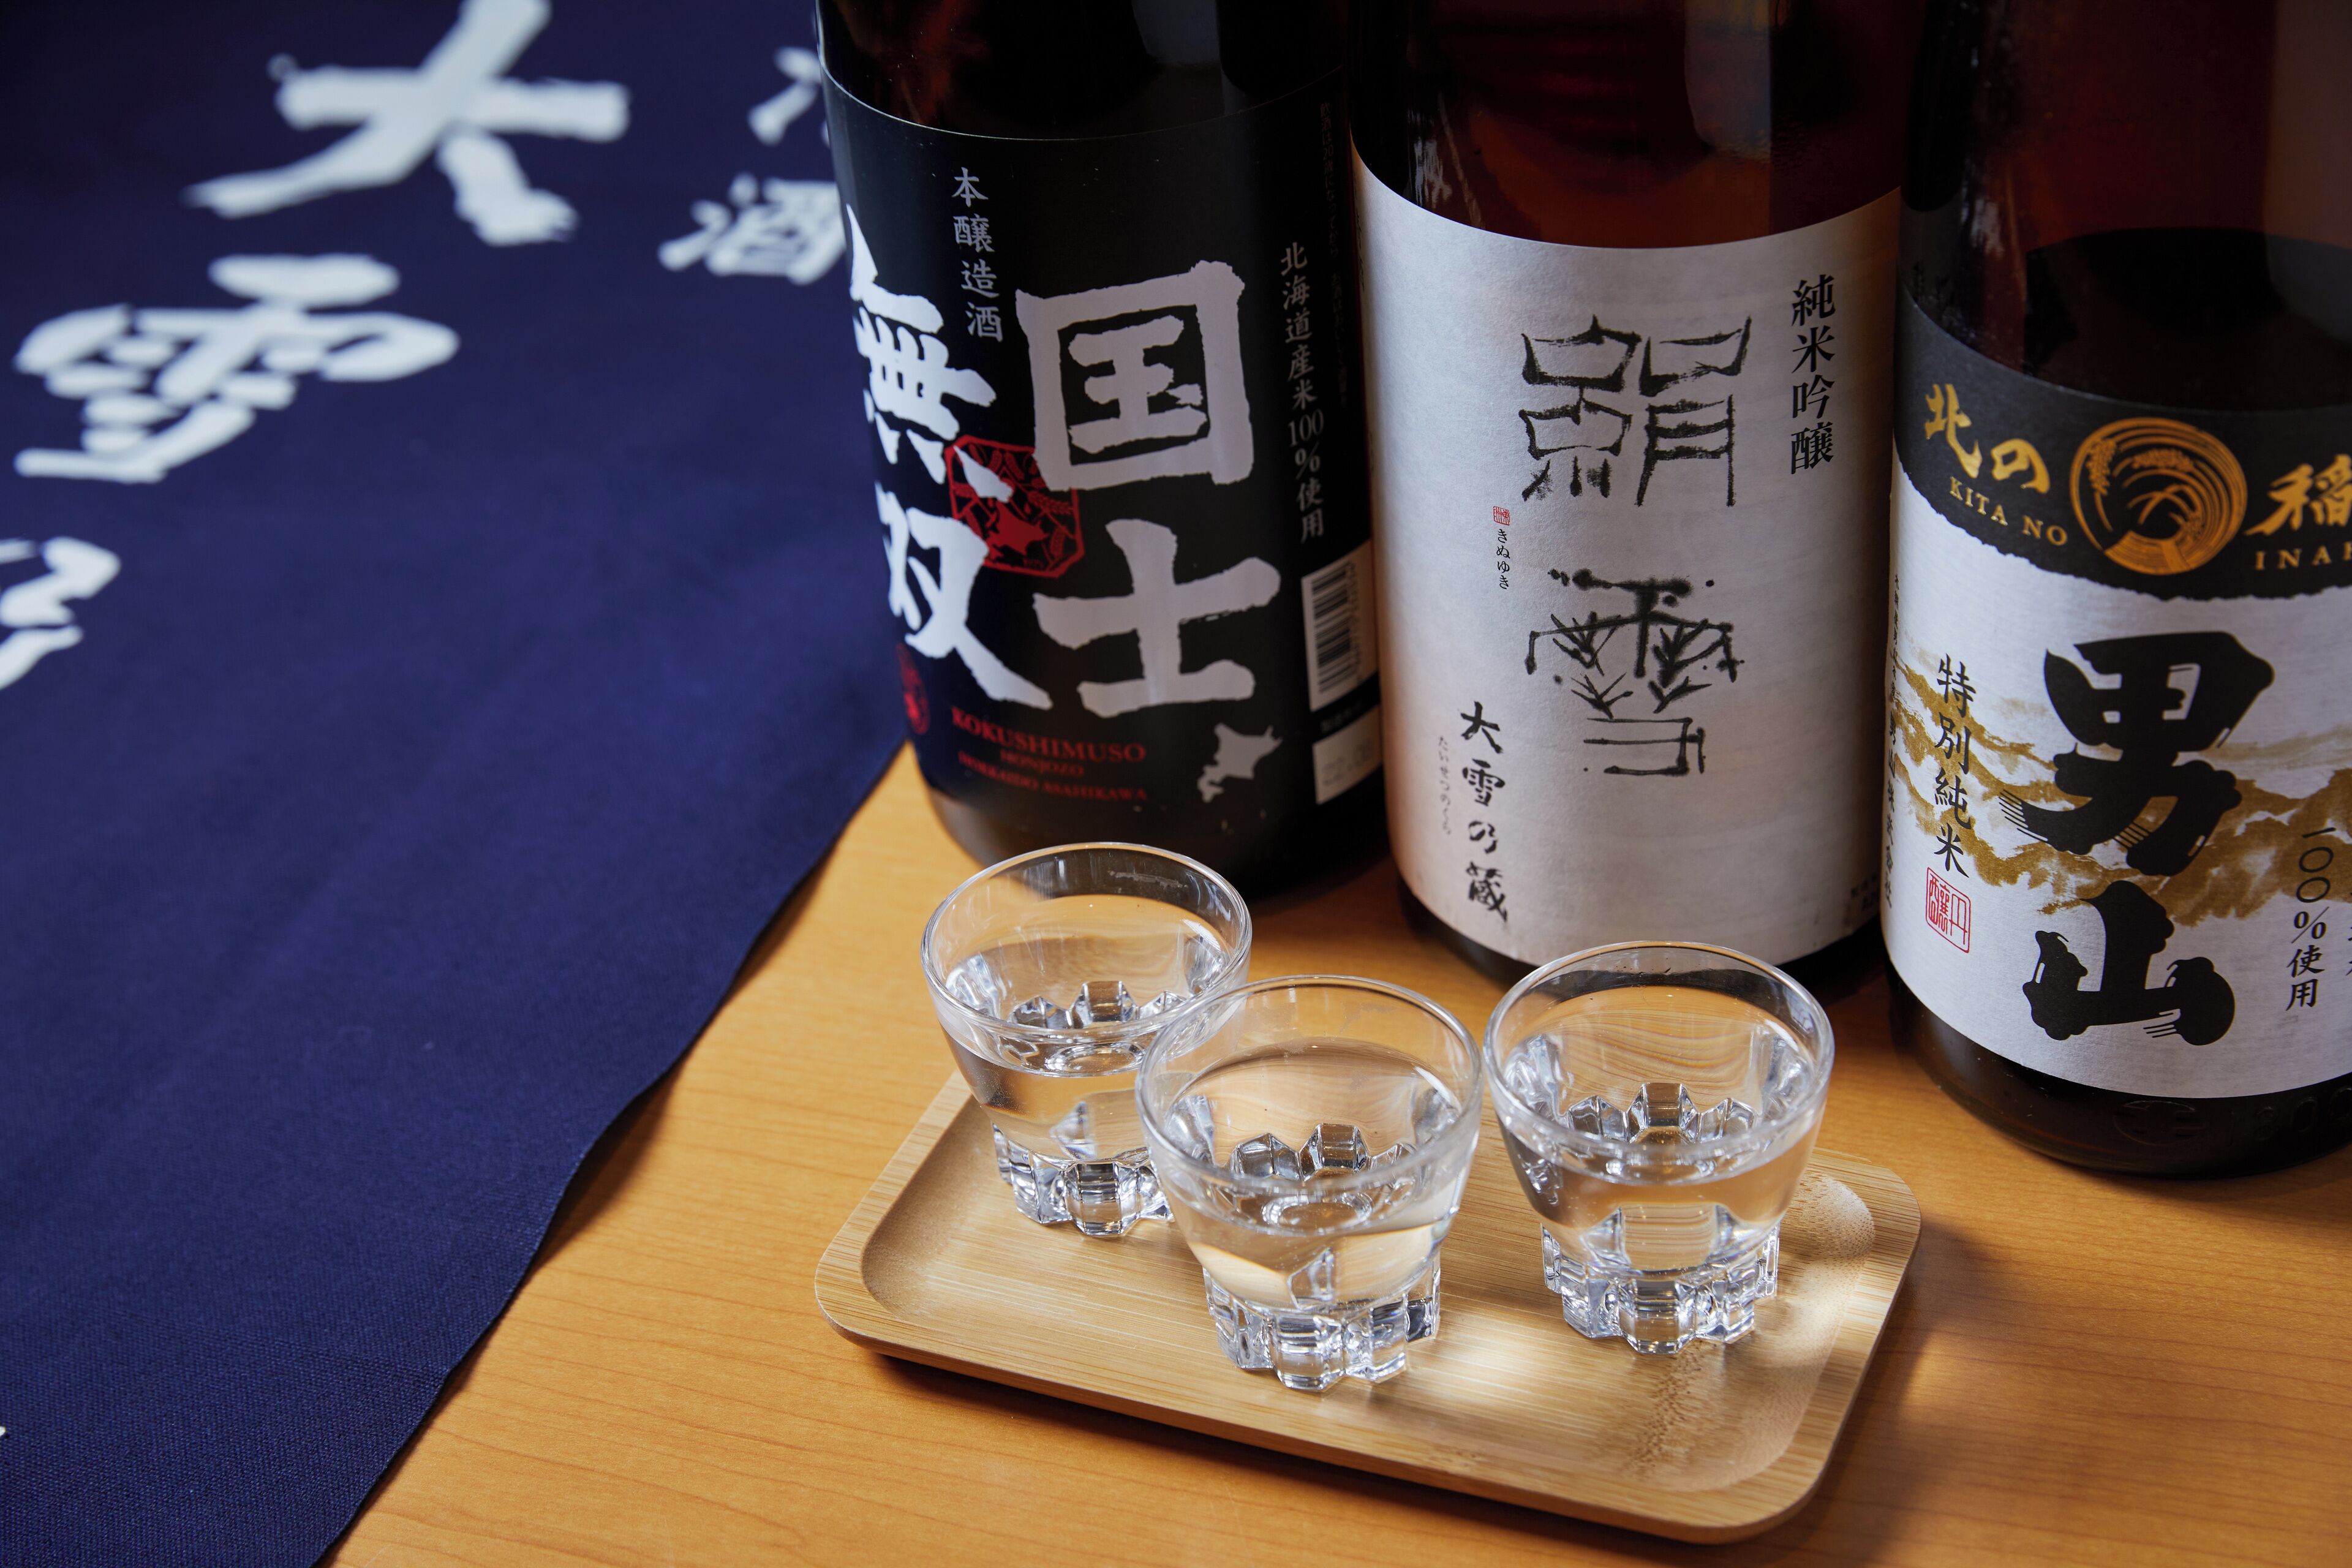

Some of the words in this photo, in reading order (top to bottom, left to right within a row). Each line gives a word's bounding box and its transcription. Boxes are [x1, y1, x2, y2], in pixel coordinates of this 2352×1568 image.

[952, 167, 1003, 342] 本醸造酒
[1790, 273, 1837, 475] 純米吟醸
[1924, 383, 2052, 495] 北の
[1016, 260, 1281, 718] 国士
[1496, 528, 1510, 590] きぬゆき
[1948, 475, 2009, 527] KITA
[2021, 514, 2069, 548] NO
[951, 706, 1147, 763] KOKUSHIMUSO
[1932, 652, 1978, 880] 特別純米
[1998, 630, 2275, 1046] 男山
